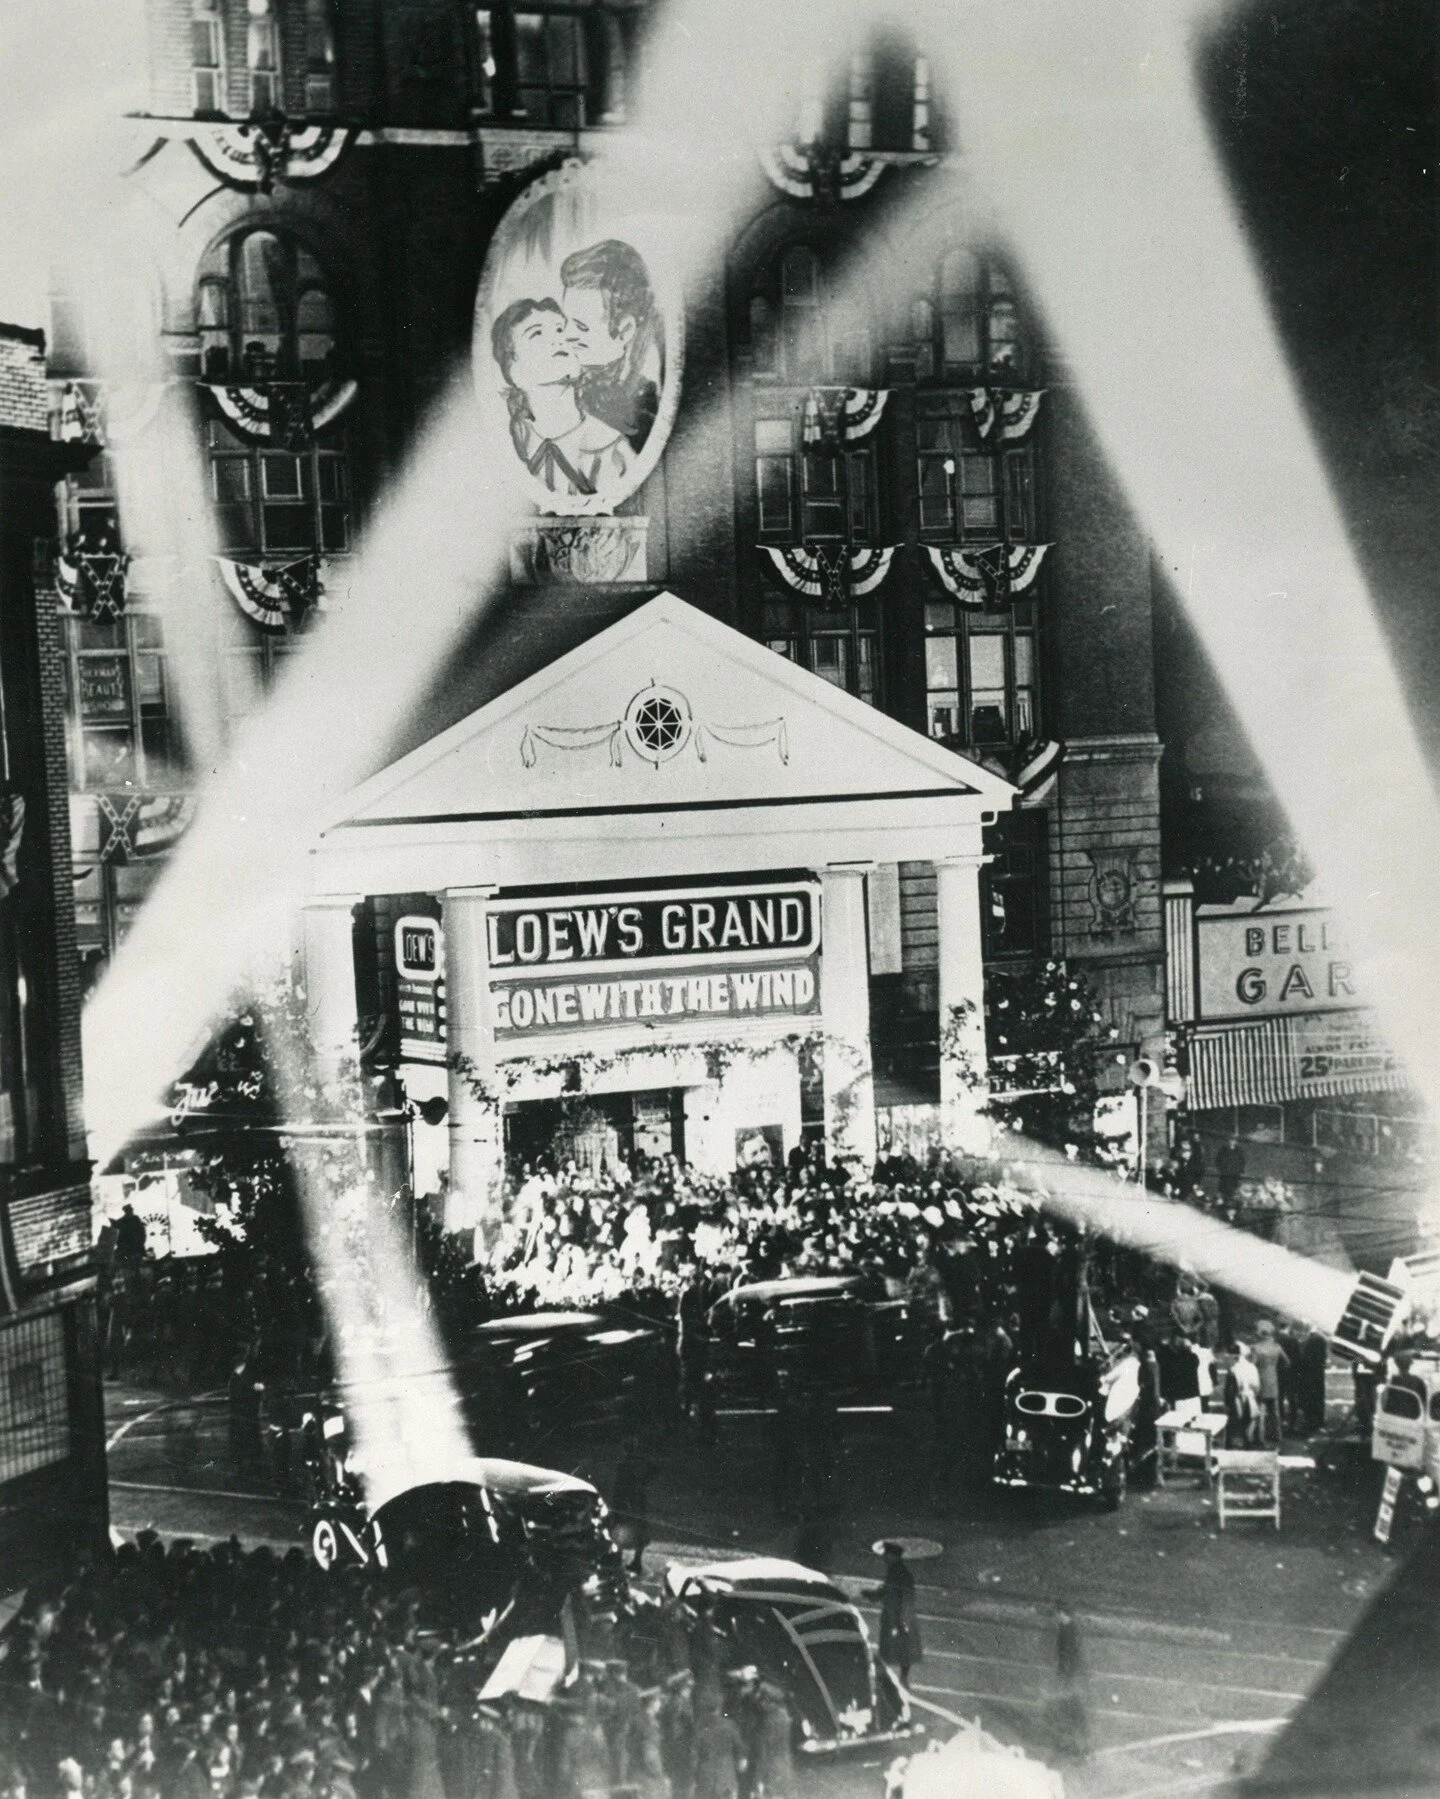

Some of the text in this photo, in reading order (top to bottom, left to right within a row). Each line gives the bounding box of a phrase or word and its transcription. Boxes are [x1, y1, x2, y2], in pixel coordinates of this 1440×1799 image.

[487, 897, 805, 966] LOEW'S GRAND
[493, 967, 815, 1029] GONE WITH THE WIND
